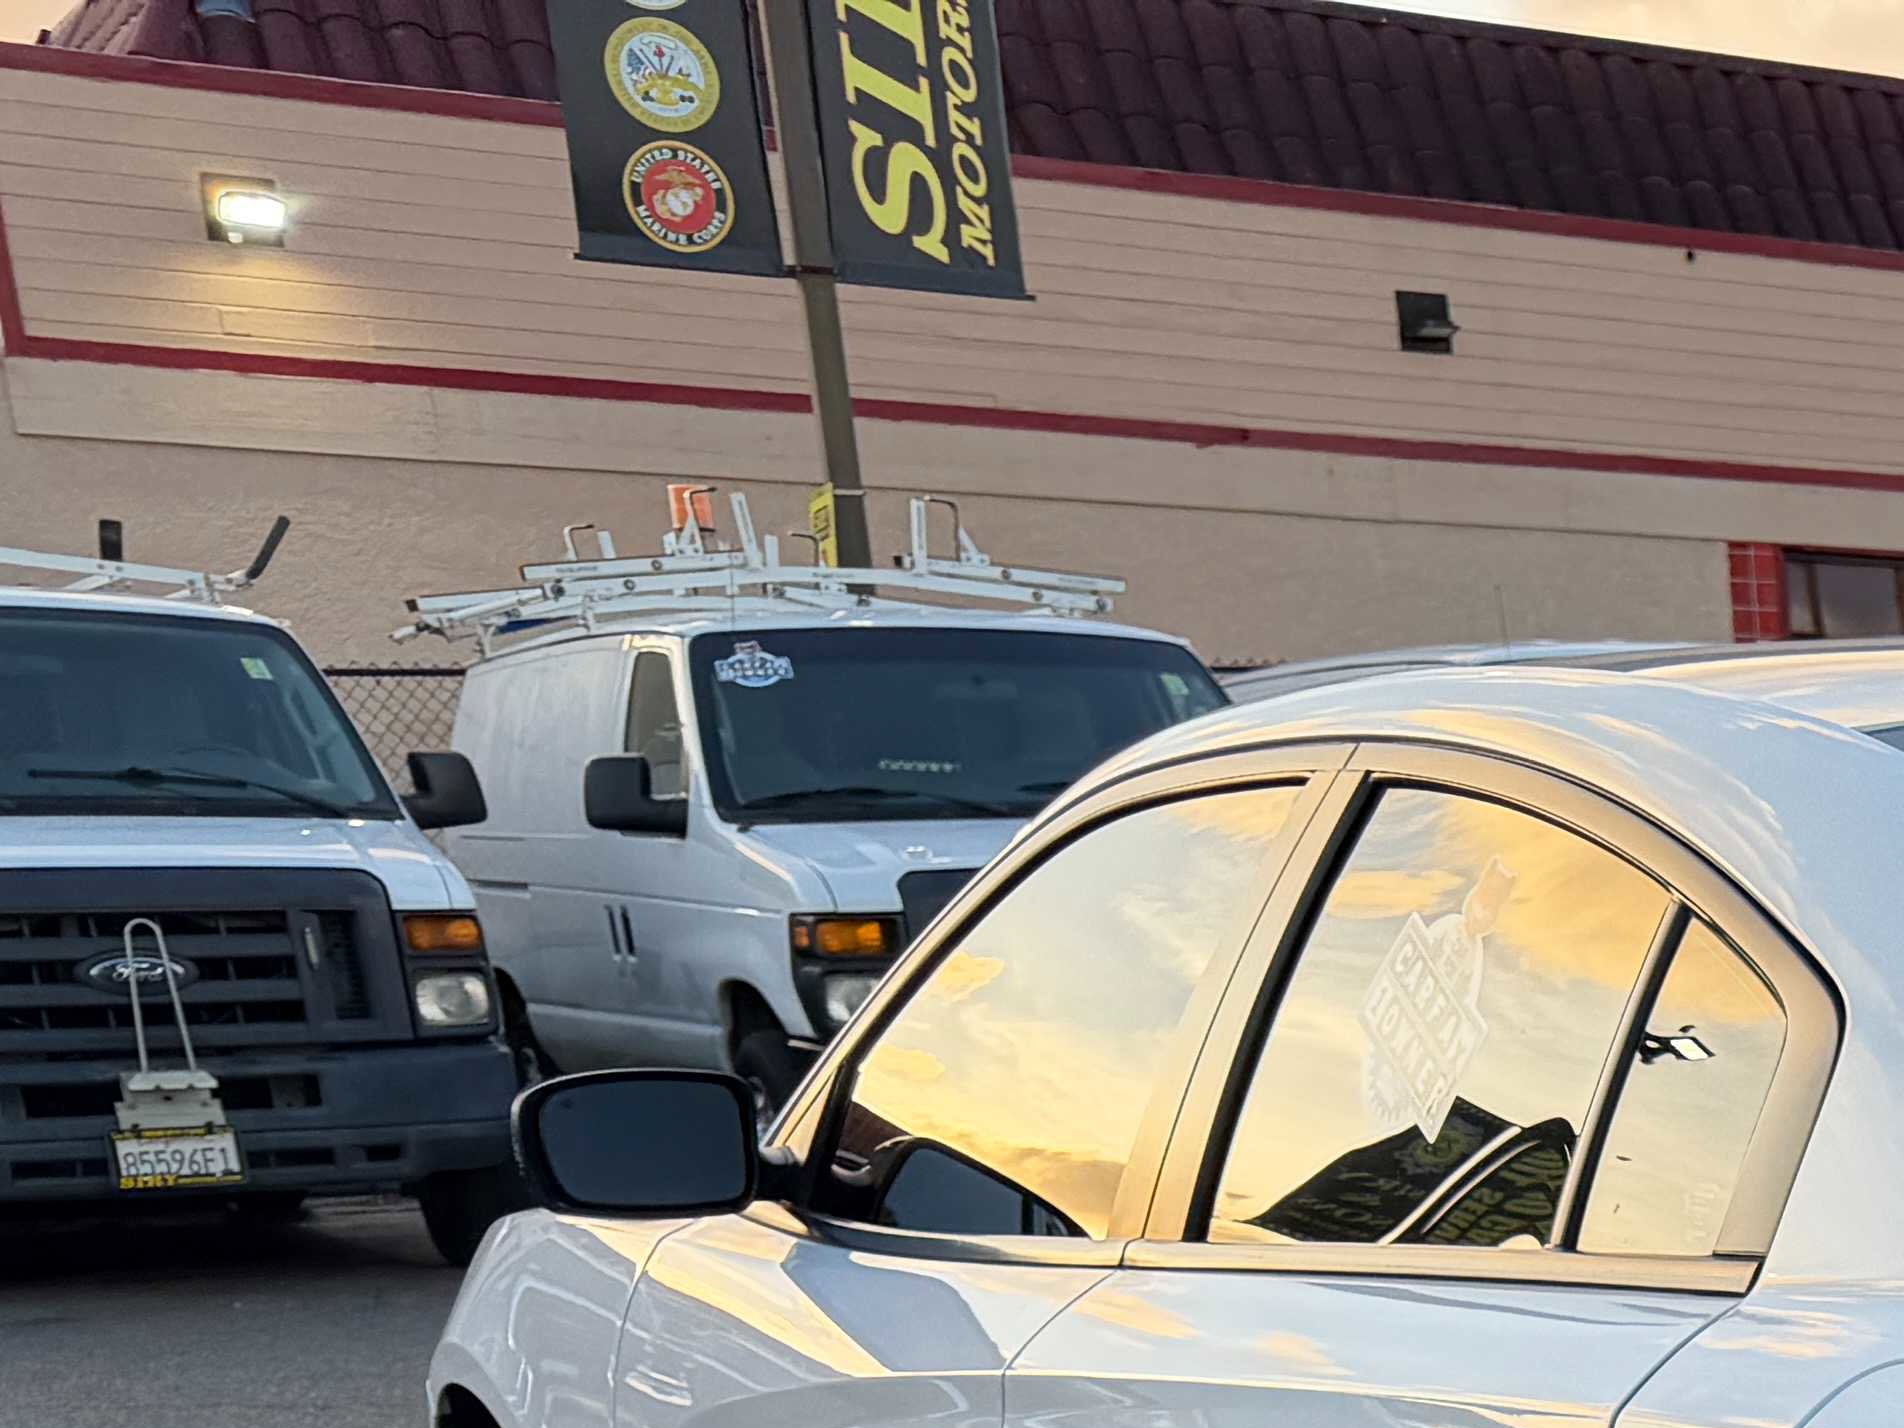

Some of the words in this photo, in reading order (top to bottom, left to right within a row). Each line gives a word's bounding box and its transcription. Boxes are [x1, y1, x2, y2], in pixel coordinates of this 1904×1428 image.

[631, 148, 673, 183] UNITED
[677, 149, 723, 190] STATES
[636, 204, 689, 245] MARINE
[692, 210, 727, 245] CORPS
